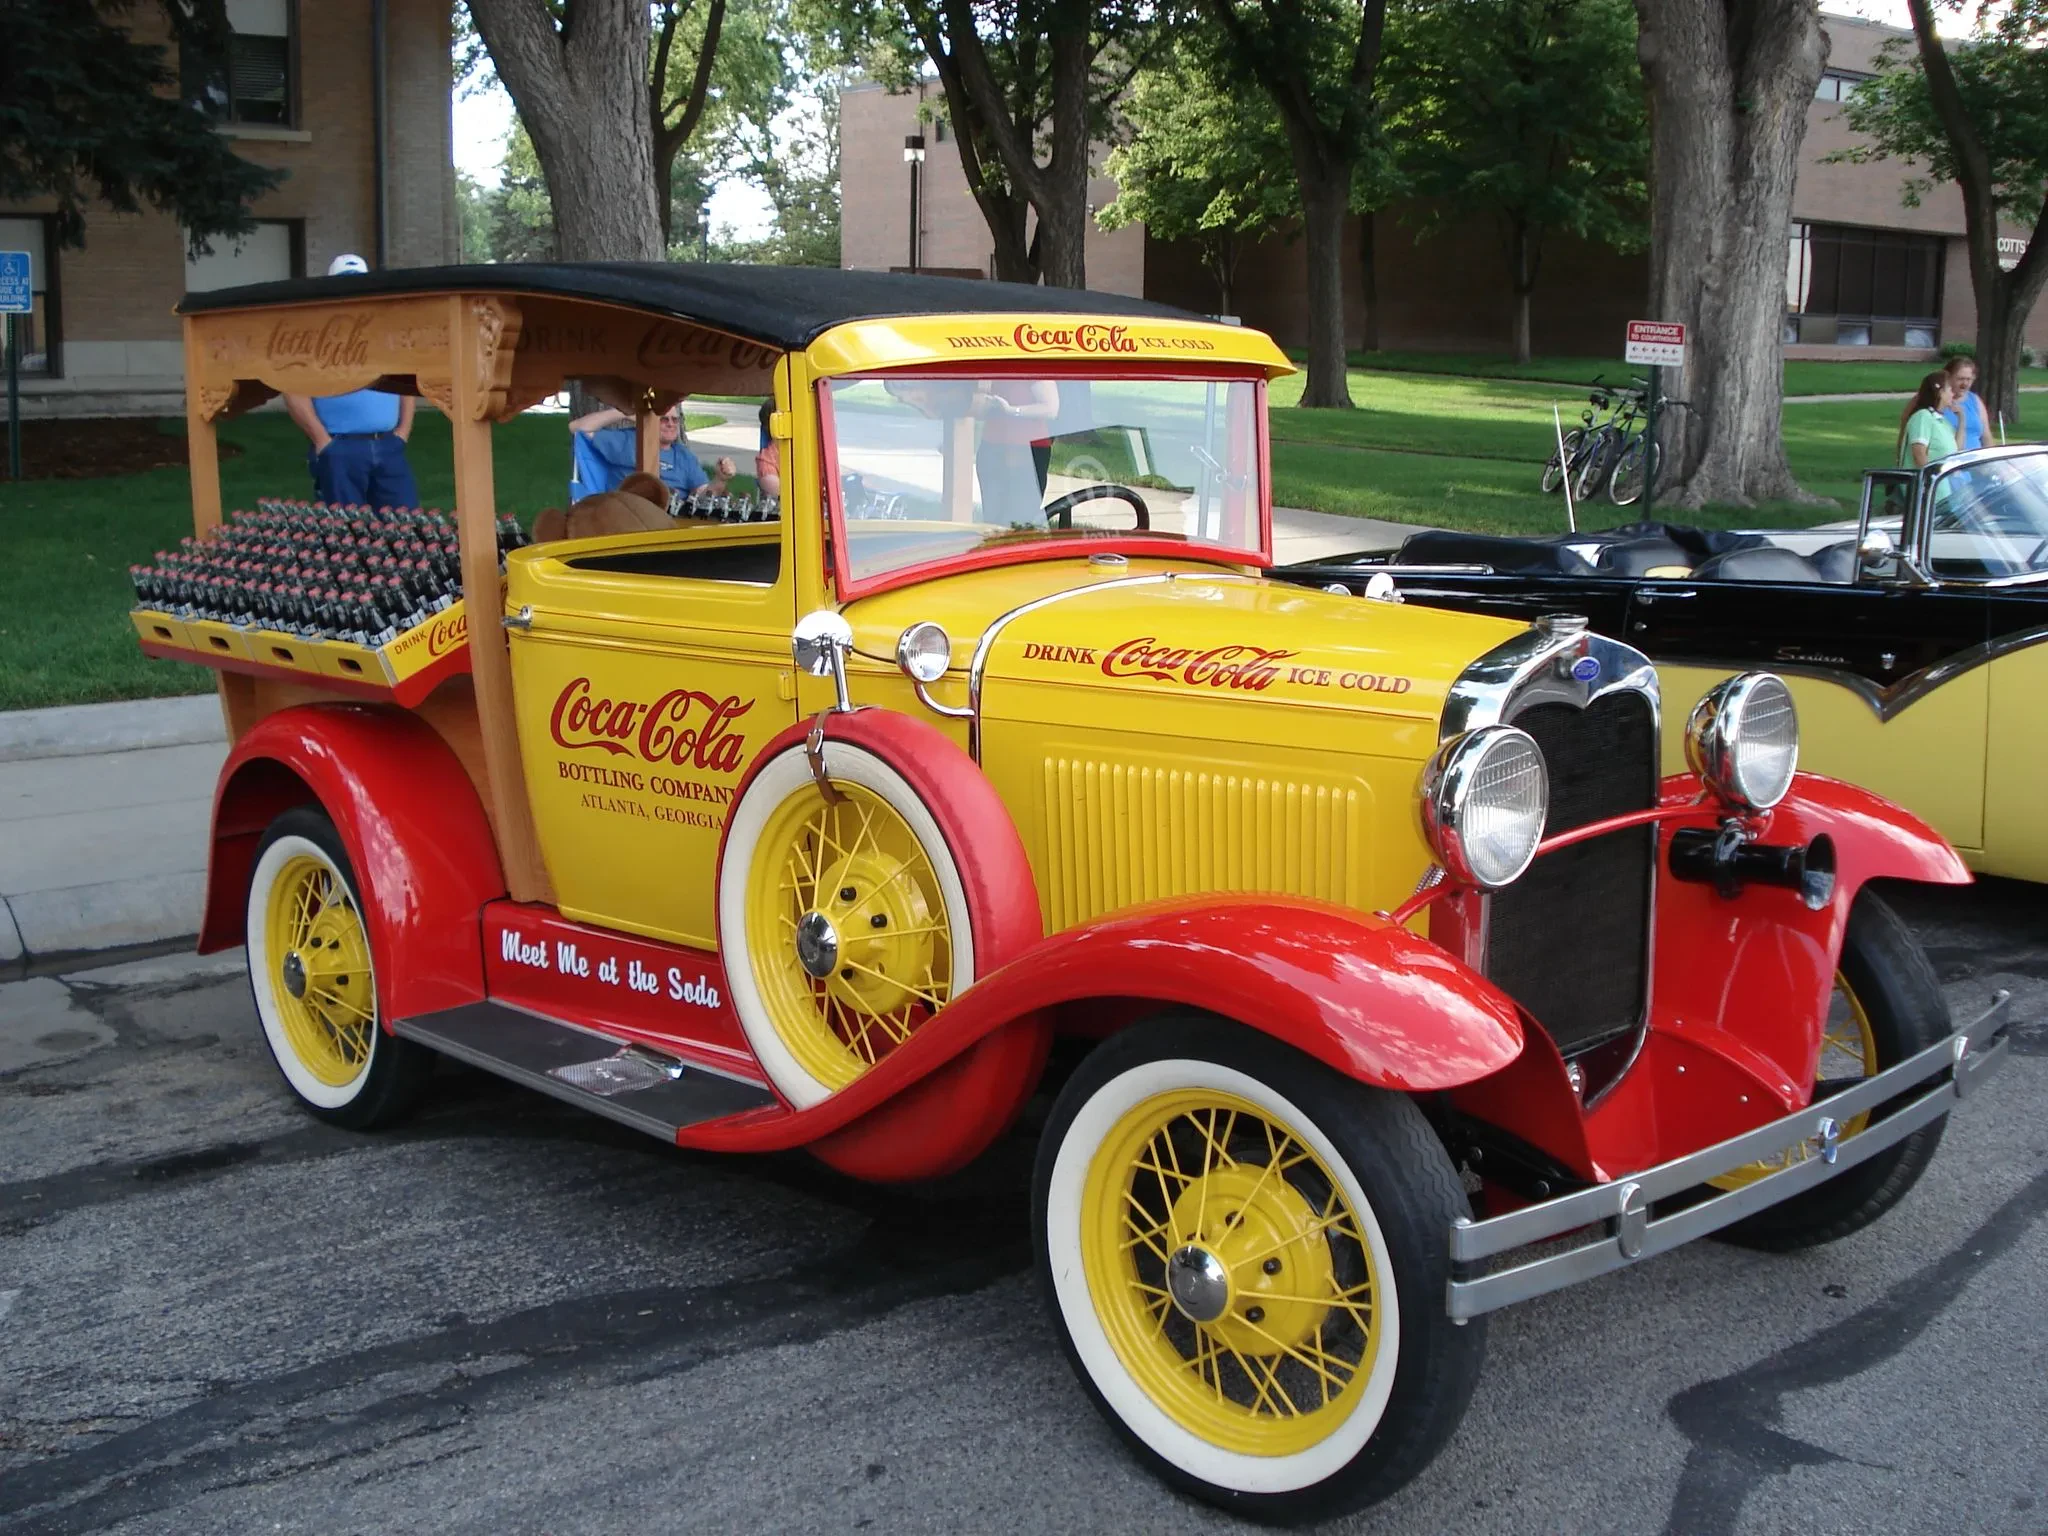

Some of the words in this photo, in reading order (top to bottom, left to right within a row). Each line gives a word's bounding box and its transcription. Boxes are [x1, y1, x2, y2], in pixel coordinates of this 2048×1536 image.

[946, 336, 1011, 349] DRINK
[1013, 323, 1138, 352] Coca-Cola
[1141, 337, 1167, 348] ICE
[1173, 338, 1214, 350] COLD
[1633, 324, 1679, 336] ENTRANCE
[394, 630, 427, 655] DRINK
[1022, 643, 1096, 665] DRINK
[1101, 637, 1300, 691] Coca-Cola
[1287, 667, 1330, 686] ICE
[1339, 672, 1411, 695] COLD
[550, 677, 756, 773] Coca-Cola
[558, 760, 644, 791] BOTTLING
[581, 794, 650, 821] ATLANTA,
[654, 806, 723, 830] GEORGIA
[502, 929, 549, 968] Meet
[557, 941, 590, 978] Me
[598, 957, 620, 985] at
[628, 960, 660, 994] the
[668, 968, 721, 1008] Soda
